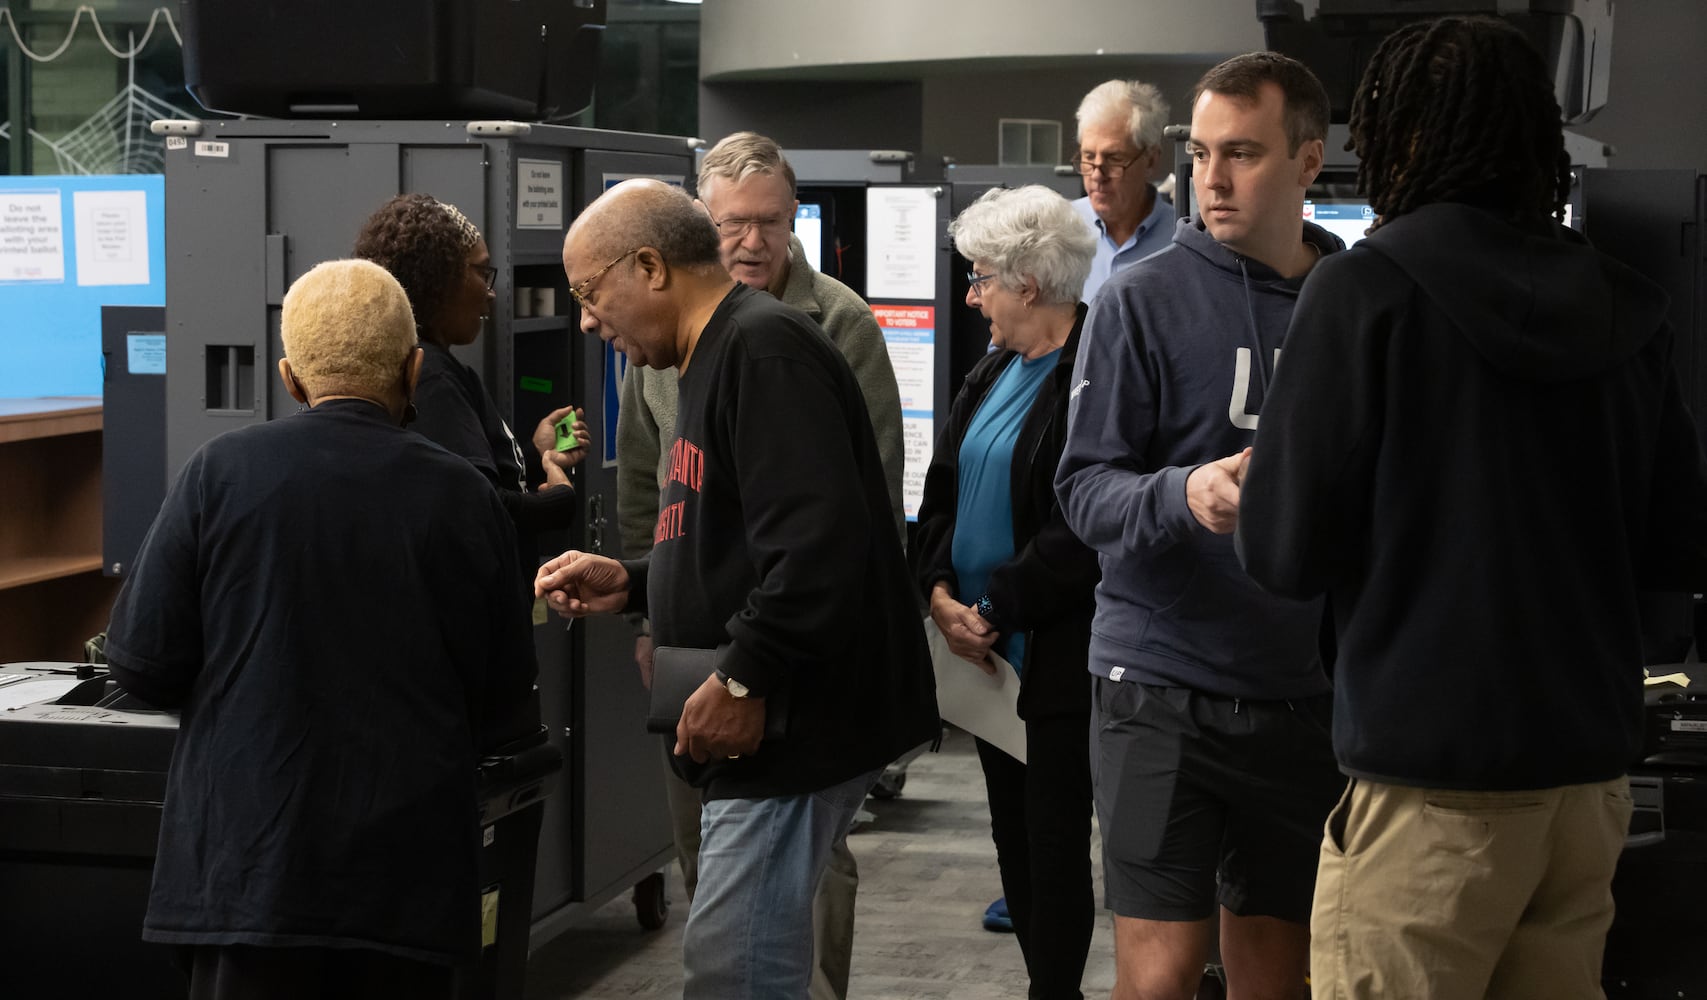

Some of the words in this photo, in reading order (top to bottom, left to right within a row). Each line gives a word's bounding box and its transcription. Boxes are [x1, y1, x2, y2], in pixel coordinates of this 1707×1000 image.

[168, 137, 186, 146] 0493
[9, 204, 23, 213] Do
[25, 204, 41, 213] not
[4, 215, 29, 223] leave
[32, 215, 47, 223] the
[38, 226, 59, 234] area
[4, 236, 24, 244] with
[27, 237, 48, 245] your
